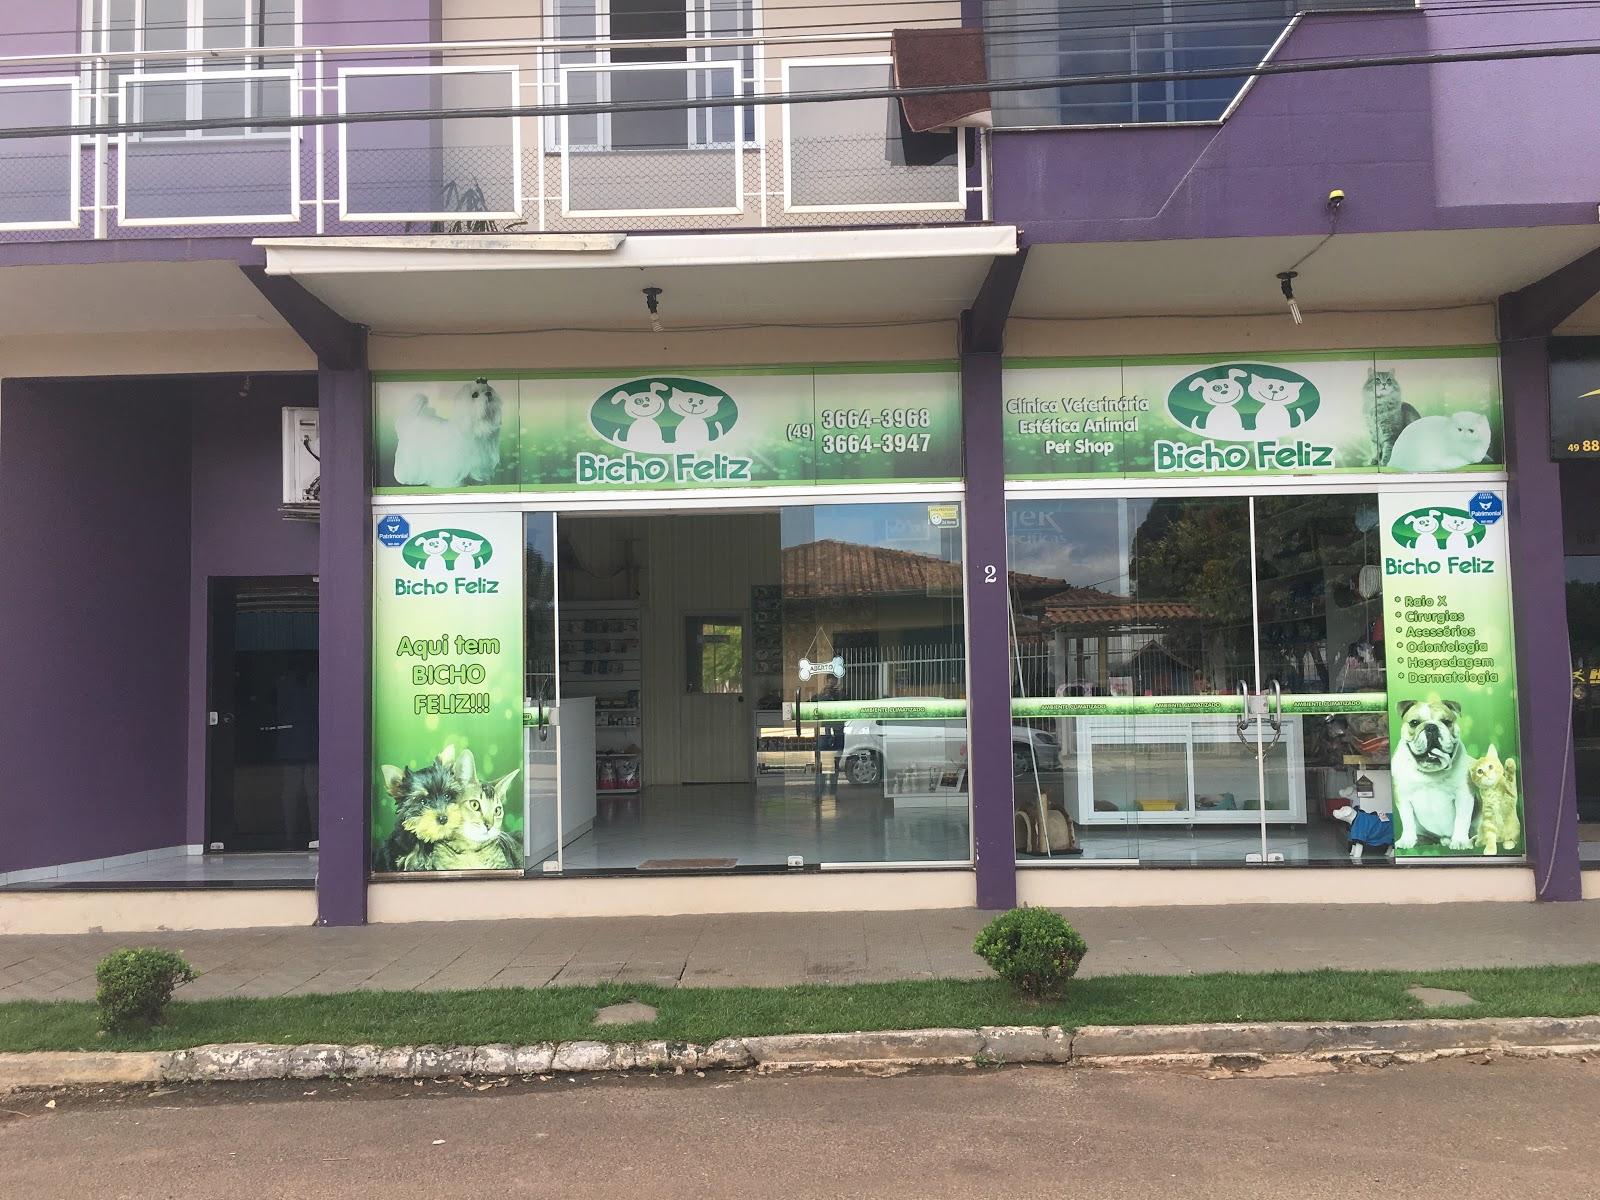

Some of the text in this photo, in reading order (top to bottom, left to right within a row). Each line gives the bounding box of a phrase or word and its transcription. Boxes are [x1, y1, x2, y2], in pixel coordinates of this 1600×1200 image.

[1006, 395, 1149, 414] Clínica Veterinária
[821, 408, 930, 429] 3664-3968
[1018, 416, 1138, 434] Estética Animal
[786, 423, 815, 441] (49)
[821, 433, 931, 454] 3664-3947
[1045, 439, 1114, 457] Pet Shop
[1567, 443, 1580, 452] 49
[1156, 440, 1335, 471] Bicho Feliz
[578, 453, 750, 483] Bicho Feliz
[984, 565, 997, 583] 2
[1385, 556, 1495, 576] Bicho Feliz
[395, 577, 499, 596] Bicho Feliz
[1404, 595, 1447, 607] Raio X
[1404, 610, 1465, 625] Cirurgias
[1405, 625, 1476, 638] Acessórios
[396, 634, 500, 661] Aqui tem
[1406, 640, 1488, 654] Odontologia
[1407, 655, 1495, 669] Hospedagem
[412, 663, 486, 686] BICHO
[1407, 670, 1499, 685] Dermatologia
[414, 692, 490, 714] FELIZ!!!
